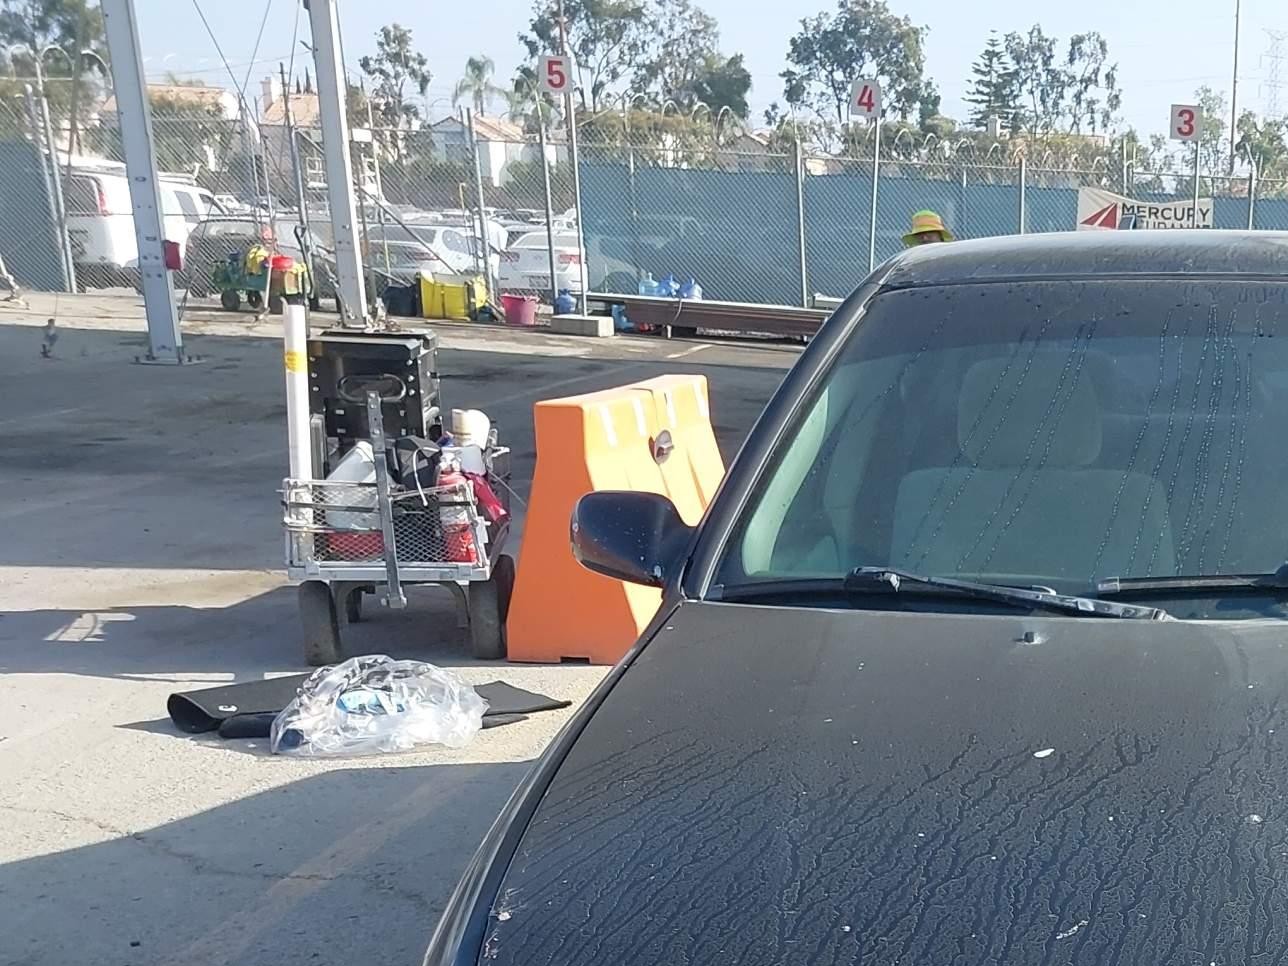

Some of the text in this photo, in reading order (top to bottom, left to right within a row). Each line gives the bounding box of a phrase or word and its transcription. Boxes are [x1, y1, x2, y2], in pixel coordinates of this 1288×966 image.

[547, 60, 566, 89] 5
[857, 85, 875, 113] 4
[1177, 109, 1195, 137] 3
